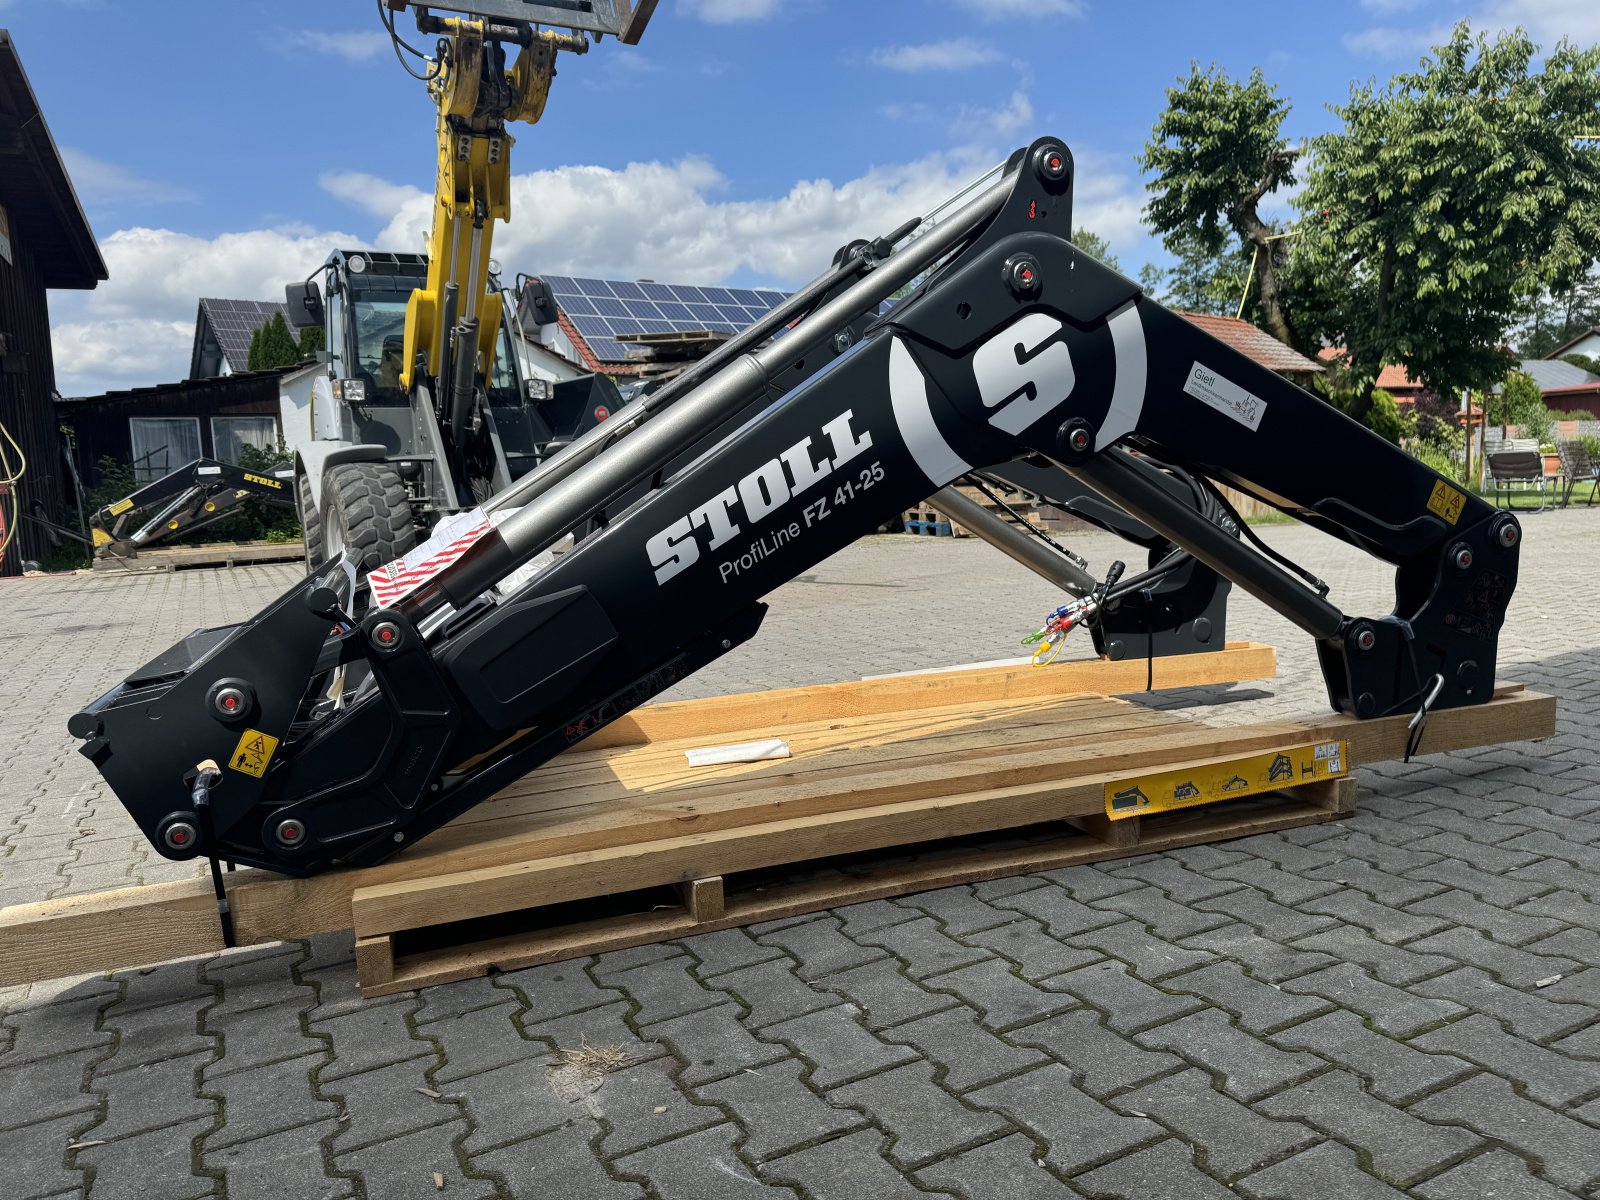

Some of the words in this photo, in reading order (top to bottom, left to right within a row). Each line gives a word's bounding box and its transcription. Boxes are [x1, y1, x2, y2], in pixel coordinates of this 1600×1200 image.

[1194, 368, 1216, 387] Gietl
[243, 473, 282, 489] STOLL
[645, 408, 873, 587] STOLL
[718, 522, 801, 584] ProfiLine
[803, 496, 831, 528] FZ
[834, 461, 885, 505] 41-25
